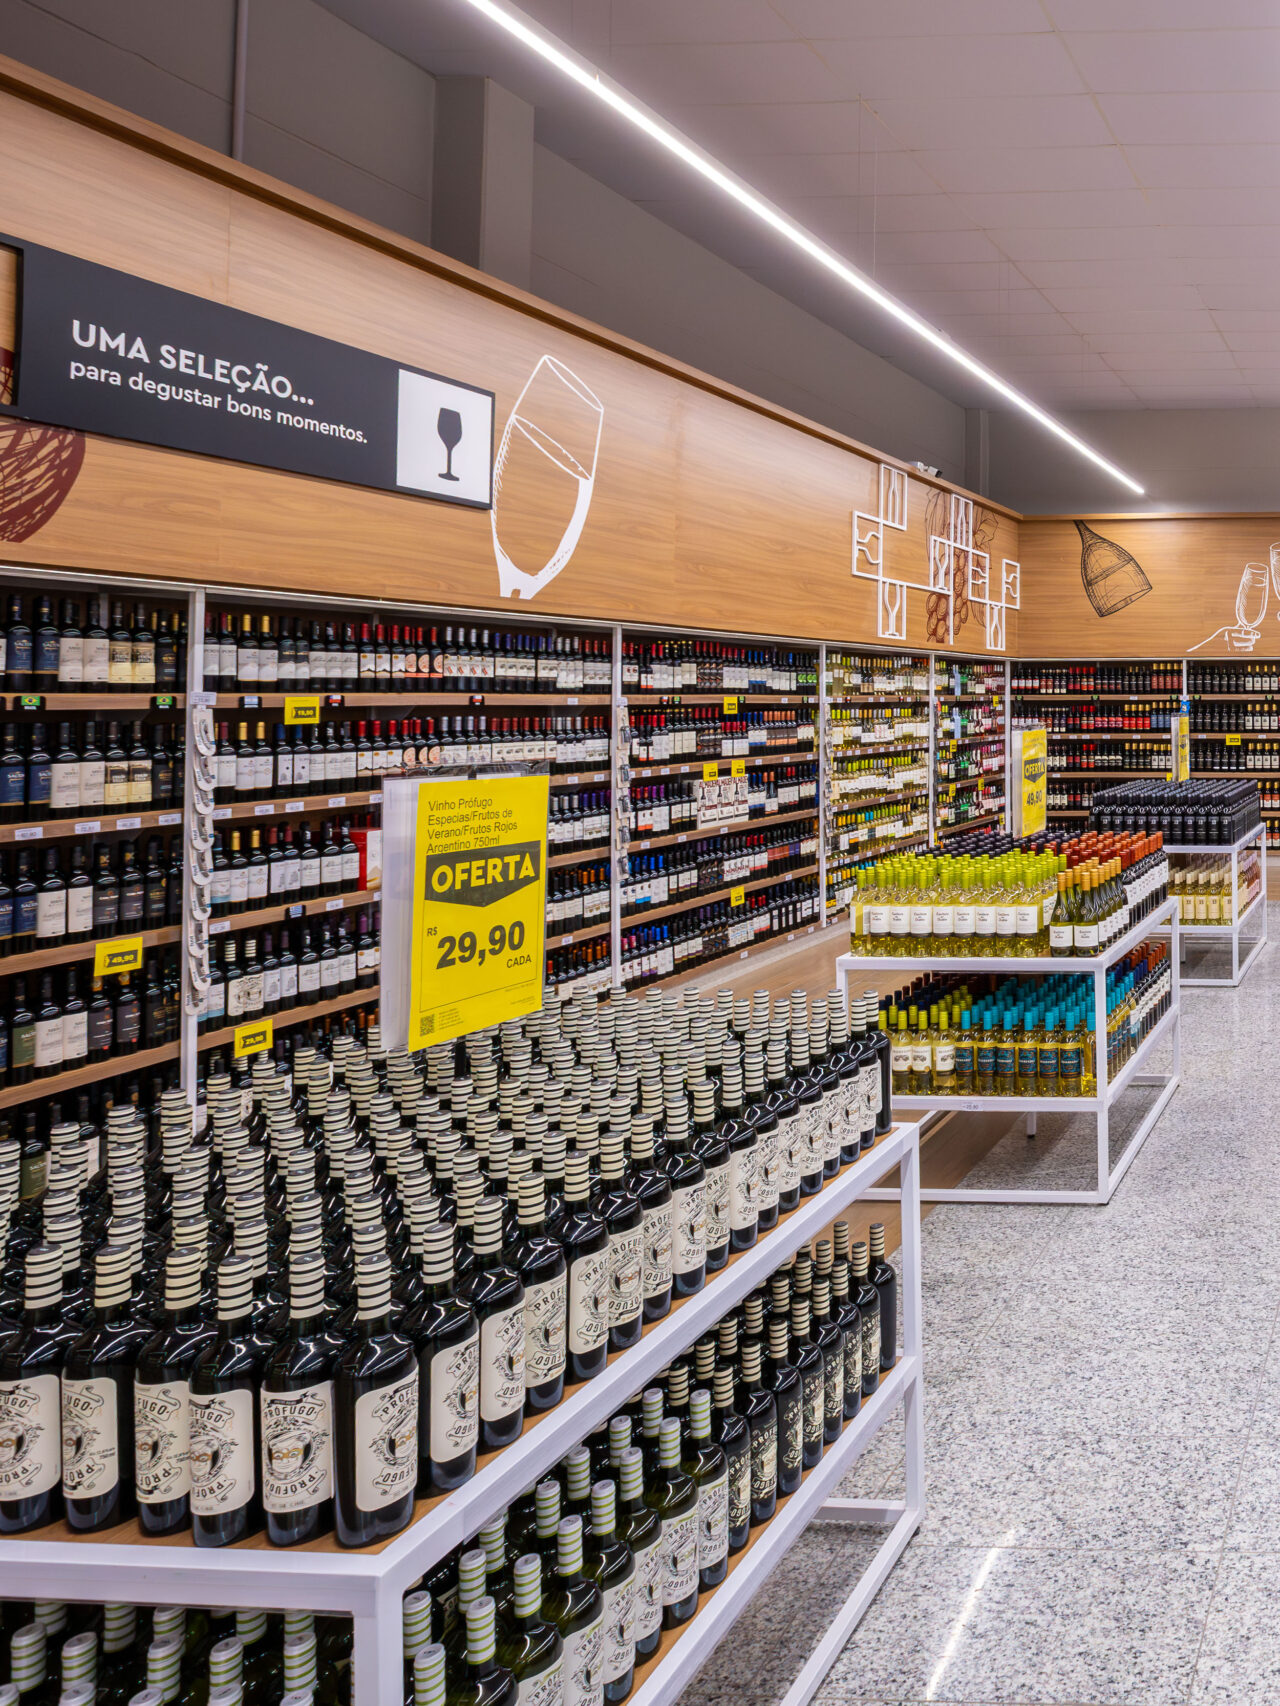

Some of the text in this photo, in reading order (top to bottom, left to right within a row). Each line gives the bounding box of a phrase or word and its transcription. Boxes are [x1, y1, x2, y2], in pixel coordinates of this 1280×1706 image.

[72, 319, 315, 406] UMA SELEÇÃO...
[69, 360, 368, 444] para degustar bons momentos.
[1025, 761, 1045, 778] OFERTA
[428, 797, 493, 812] Vinho Prófugo
[428, 807, 513, 827] Especias/Frutos de
[427, 821, 518, 841] Verano/Frutos Rojos
[427, 835, 500, 854] Argentino 750ml
[431, 853, 536, 894] OFERTA
[427, 920, 525, 970] R$ 29,90
[506, 954, 532, 969] CADA
[264, 1404, 317, 1421] PRÓFUGO
